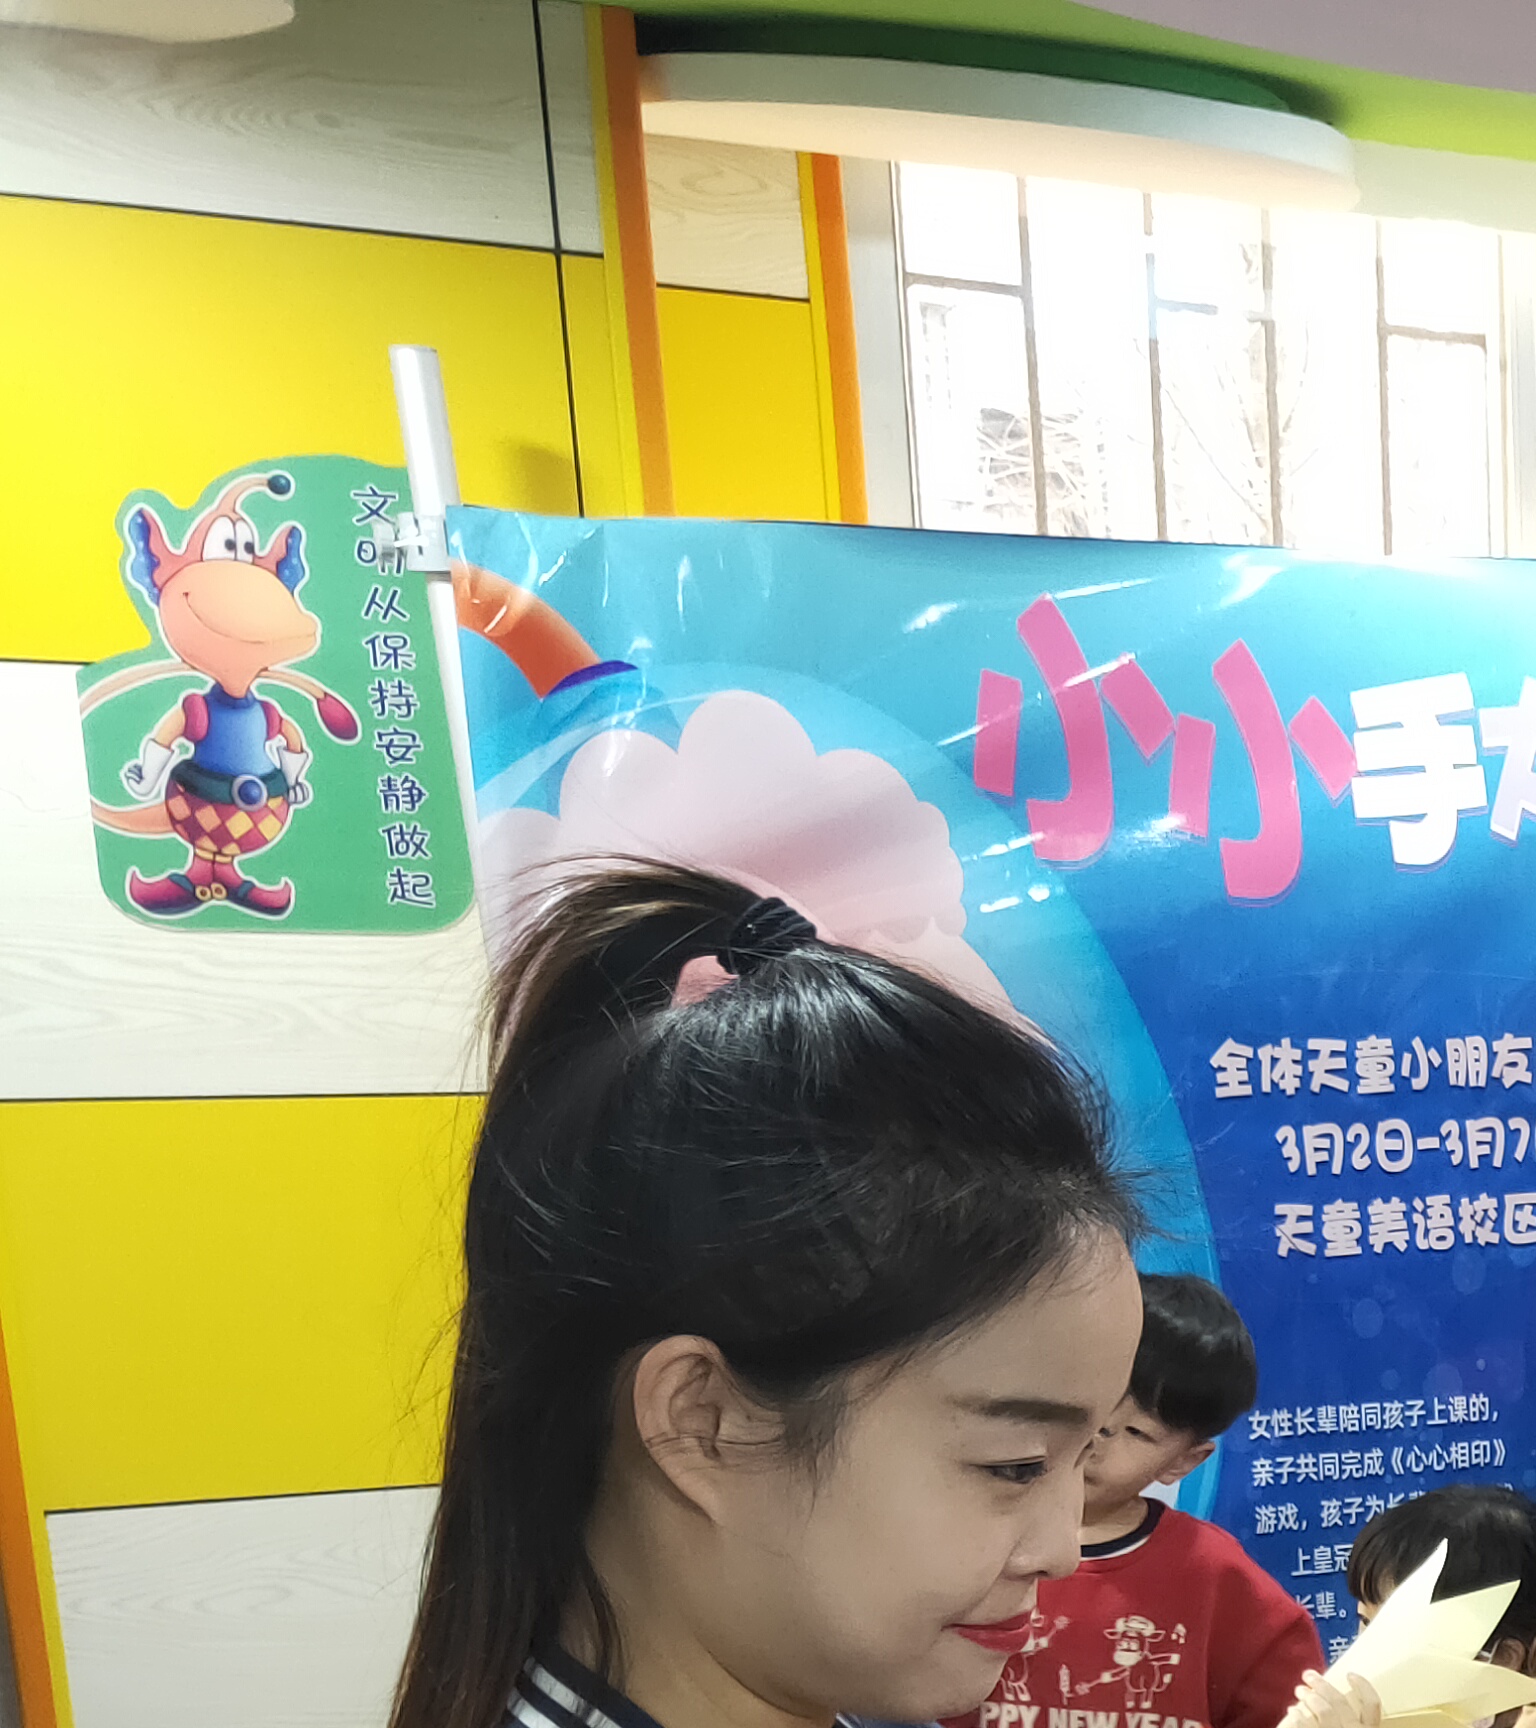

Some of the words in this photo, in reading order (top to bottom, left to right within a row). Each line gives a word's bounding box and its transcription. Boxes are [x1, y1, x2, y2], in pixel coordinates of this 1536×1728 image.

[1248, 1393, 1499, 1440] 女性长辈陪同孩子上课的，
[1251, 1438, 1507, 1487] 亲子共同完成《心心相印》
